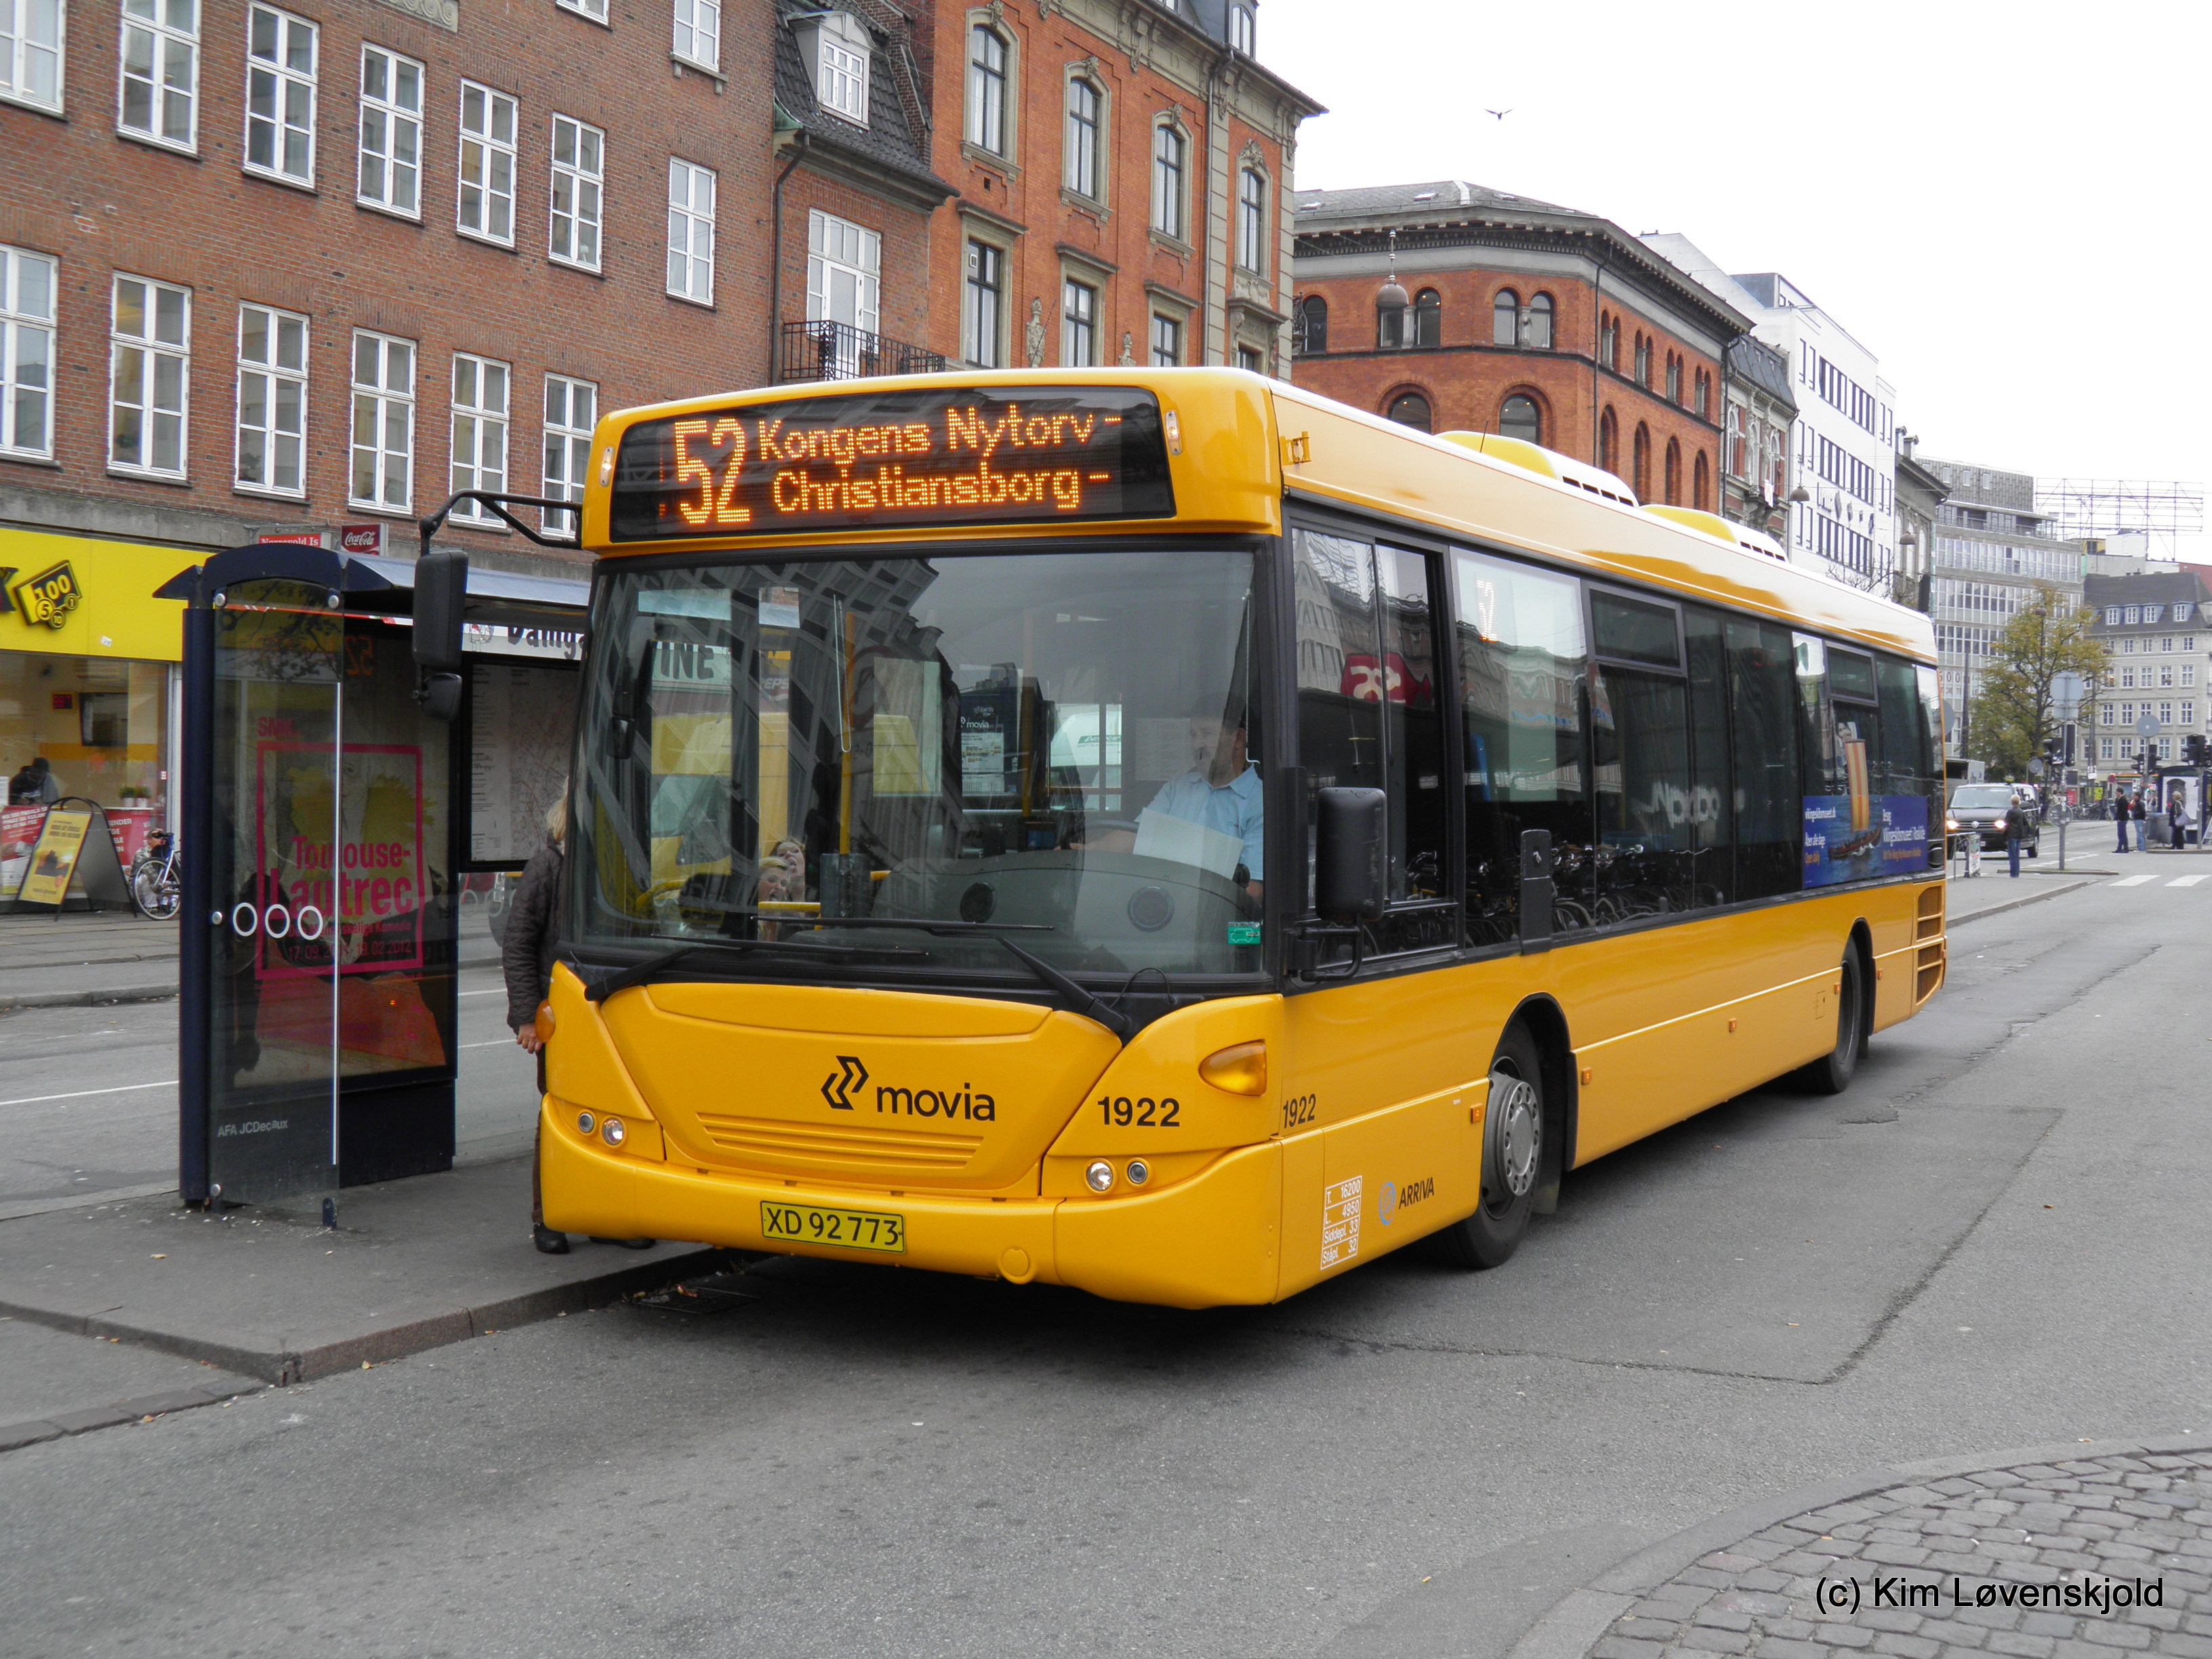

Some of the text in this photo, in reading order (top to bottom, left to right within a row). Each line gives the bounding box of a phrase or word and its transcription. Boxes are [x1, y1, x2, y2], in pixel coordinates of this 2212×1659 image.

[759, 418, 931, 466] Kongens
[675, 418, 752, 525] 52
[310, 537, 319, 546] Is
[34, 575, 71, 600] 100
[41, 603, 52, 618] 5
[966, 720, 989, 728] movia
[291, 836, 411, 870] Tououse-
[270, 867, 412, 920] Lautrec
[876, 1082, 996, 1122] movia
[1098, 1096, 1180, 1127] 1922
[1283, 1093, 1316, 1129] 1922
[218, 1120, 288, 1137] AFA JCDecaux
[1340, 1179, 1361, 1199] 16200
[1399, 1176, 1435, 1210] ARRIVA
[1343, 1199, 1359, 1218] 4950
[766, 1208, 899, 1246] XD 92 773
[1324, 1218, 1359, 1244] Siddepl. 33
[1322, 1238, 1357, 1265] Ståpl. 32
